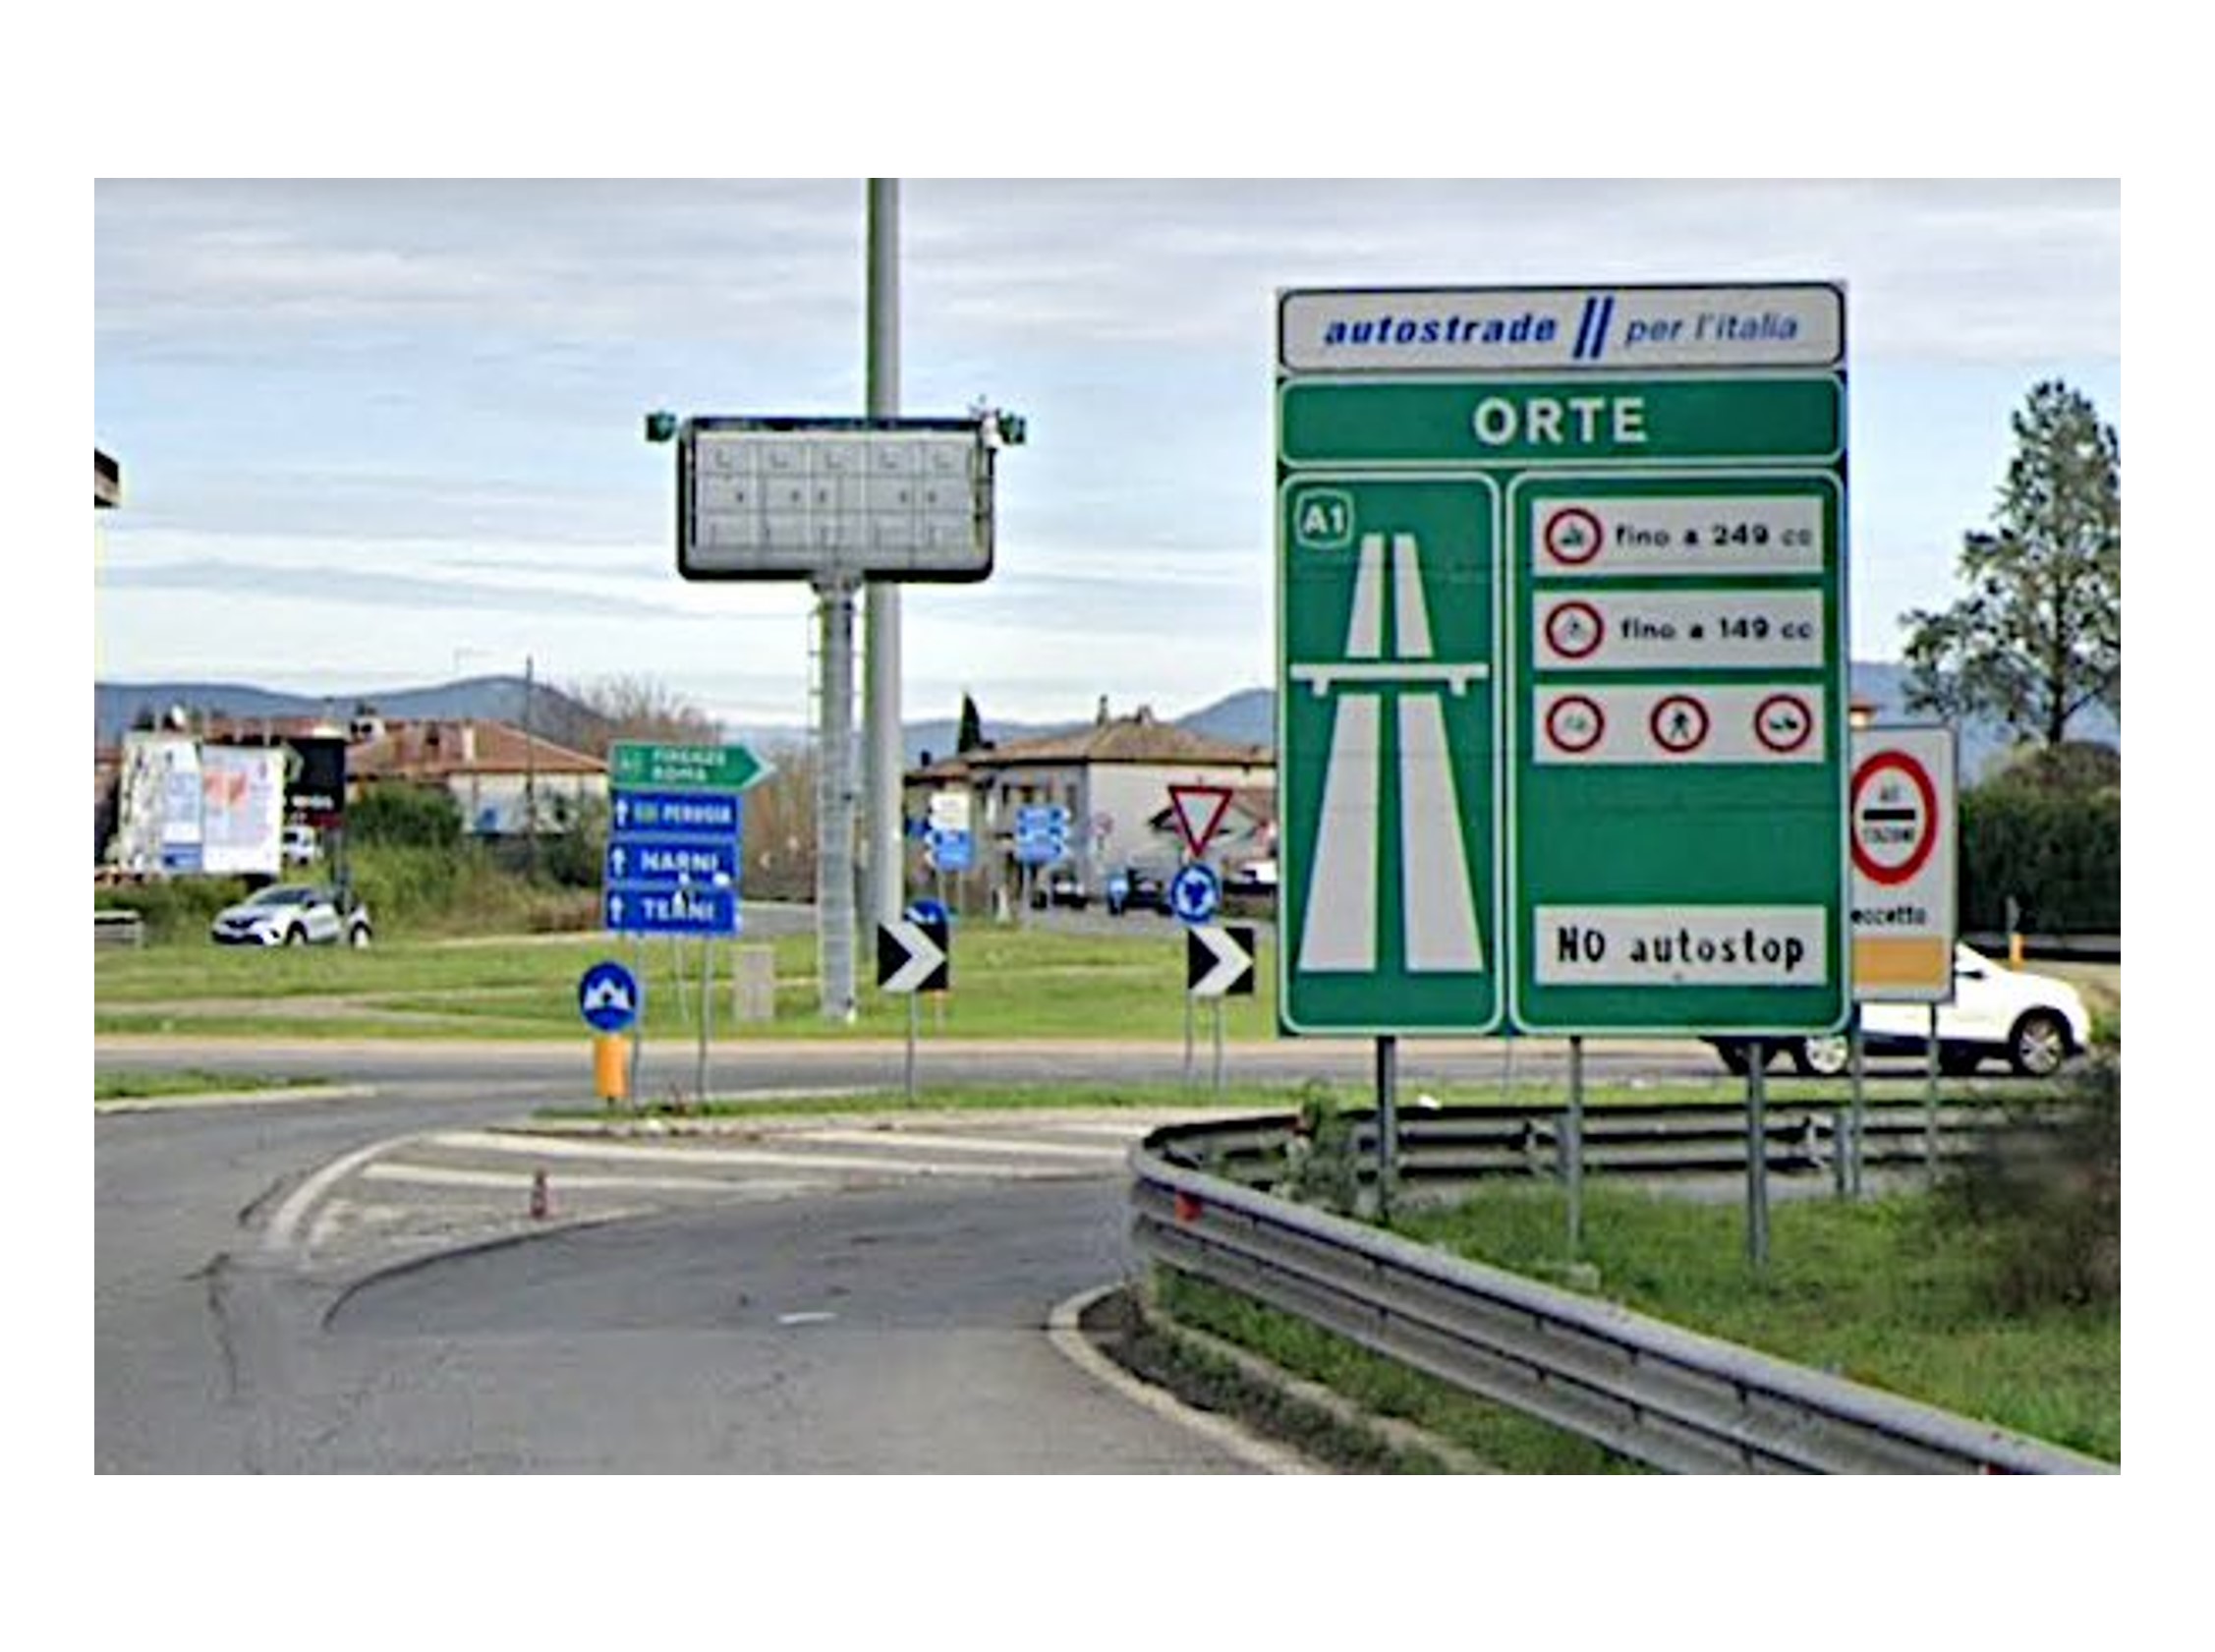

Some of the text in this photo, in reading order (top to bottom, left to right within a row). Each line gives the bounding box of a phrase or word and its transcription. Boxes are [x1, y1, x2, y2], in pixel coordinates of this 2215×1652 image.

[1324, 311, 1798, 346] autostrade per l'italia
[1474, 396, 1648, 445] ORTE
[1304, 502, 1344, 533] A1
[1616, 523, 1812, 547] fino a 249 cc
[1621, 615, 1813, 640] fino a 149 cc
[652, 765, 708, 781] ROMA
[662, 801, 731, 824] PERUGIA
[641, 848, 719, 873] NARNI
[1849, 906, 1927, 926] eccetto
[1557, 926, 1805, 972] NO autostop
